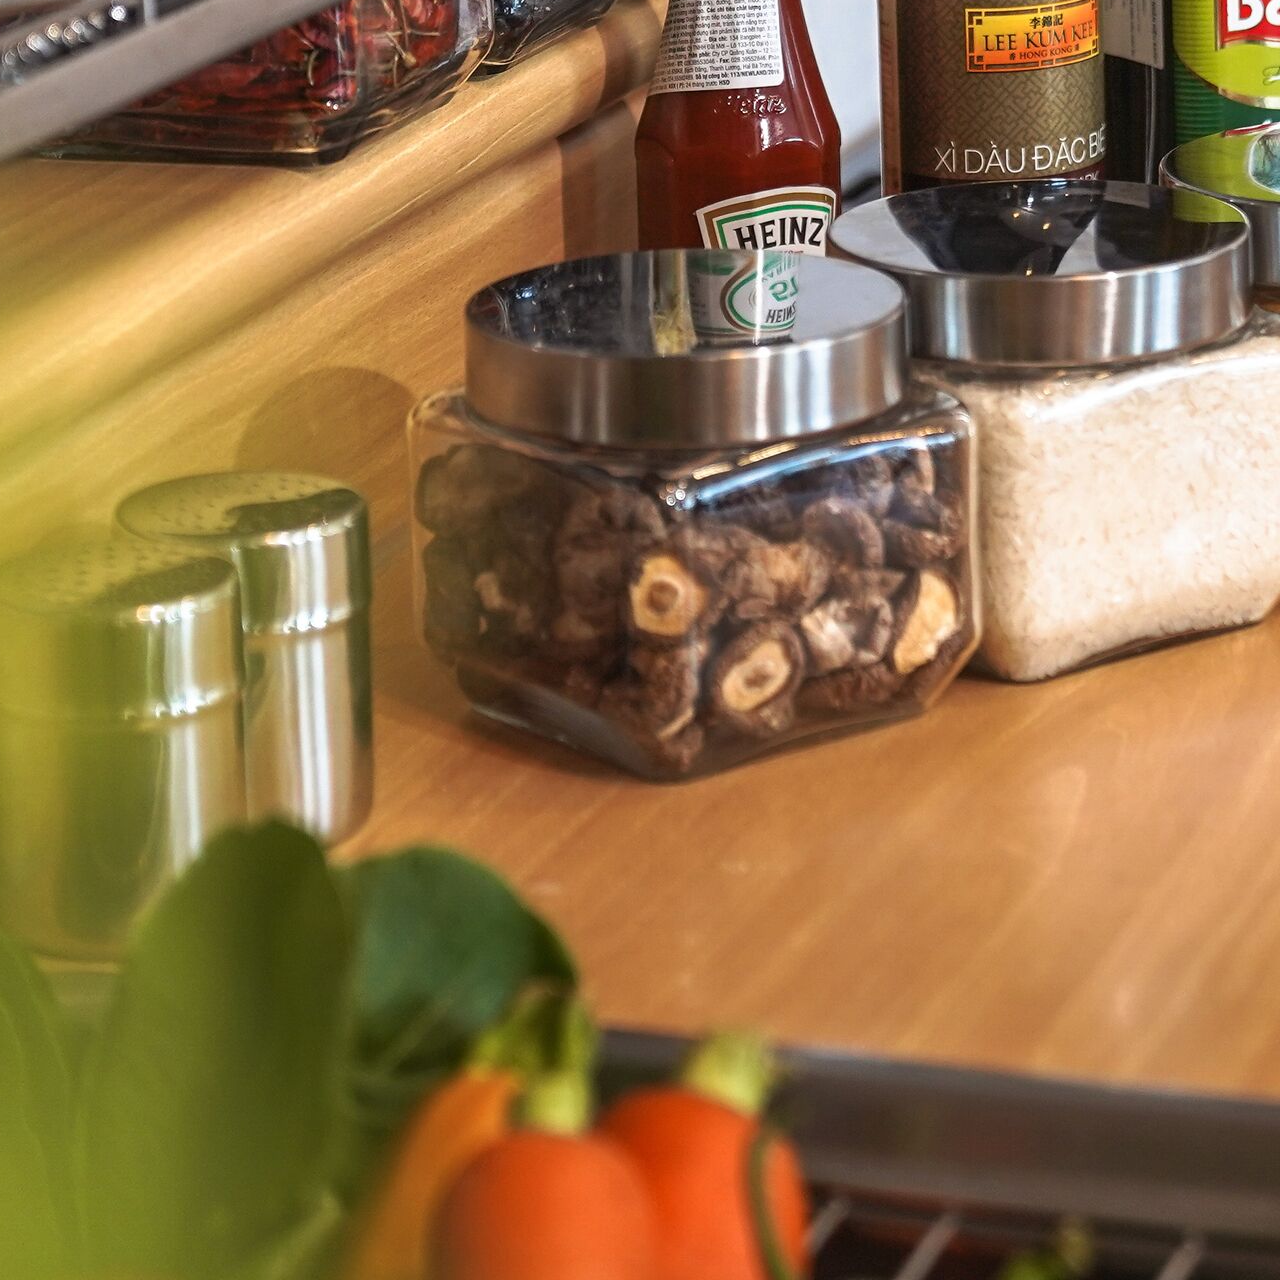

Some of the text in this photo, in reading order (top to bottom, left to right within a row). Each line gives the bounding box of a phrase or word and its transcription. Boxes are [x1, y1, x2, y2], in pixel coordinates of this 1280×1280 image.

[982, 20, 1094, 51] LEE KUM KEE
[1019, 48, 1048, 60] HONG
[1049, 44, 1073, 57] KONG
[934, 140, 956, 173] XÌ
[964, 140, 1026, 174] DẦU
[1032, 136, 1086, 171] ĐẶC
[734, 217, 824, 251] HEINZ
